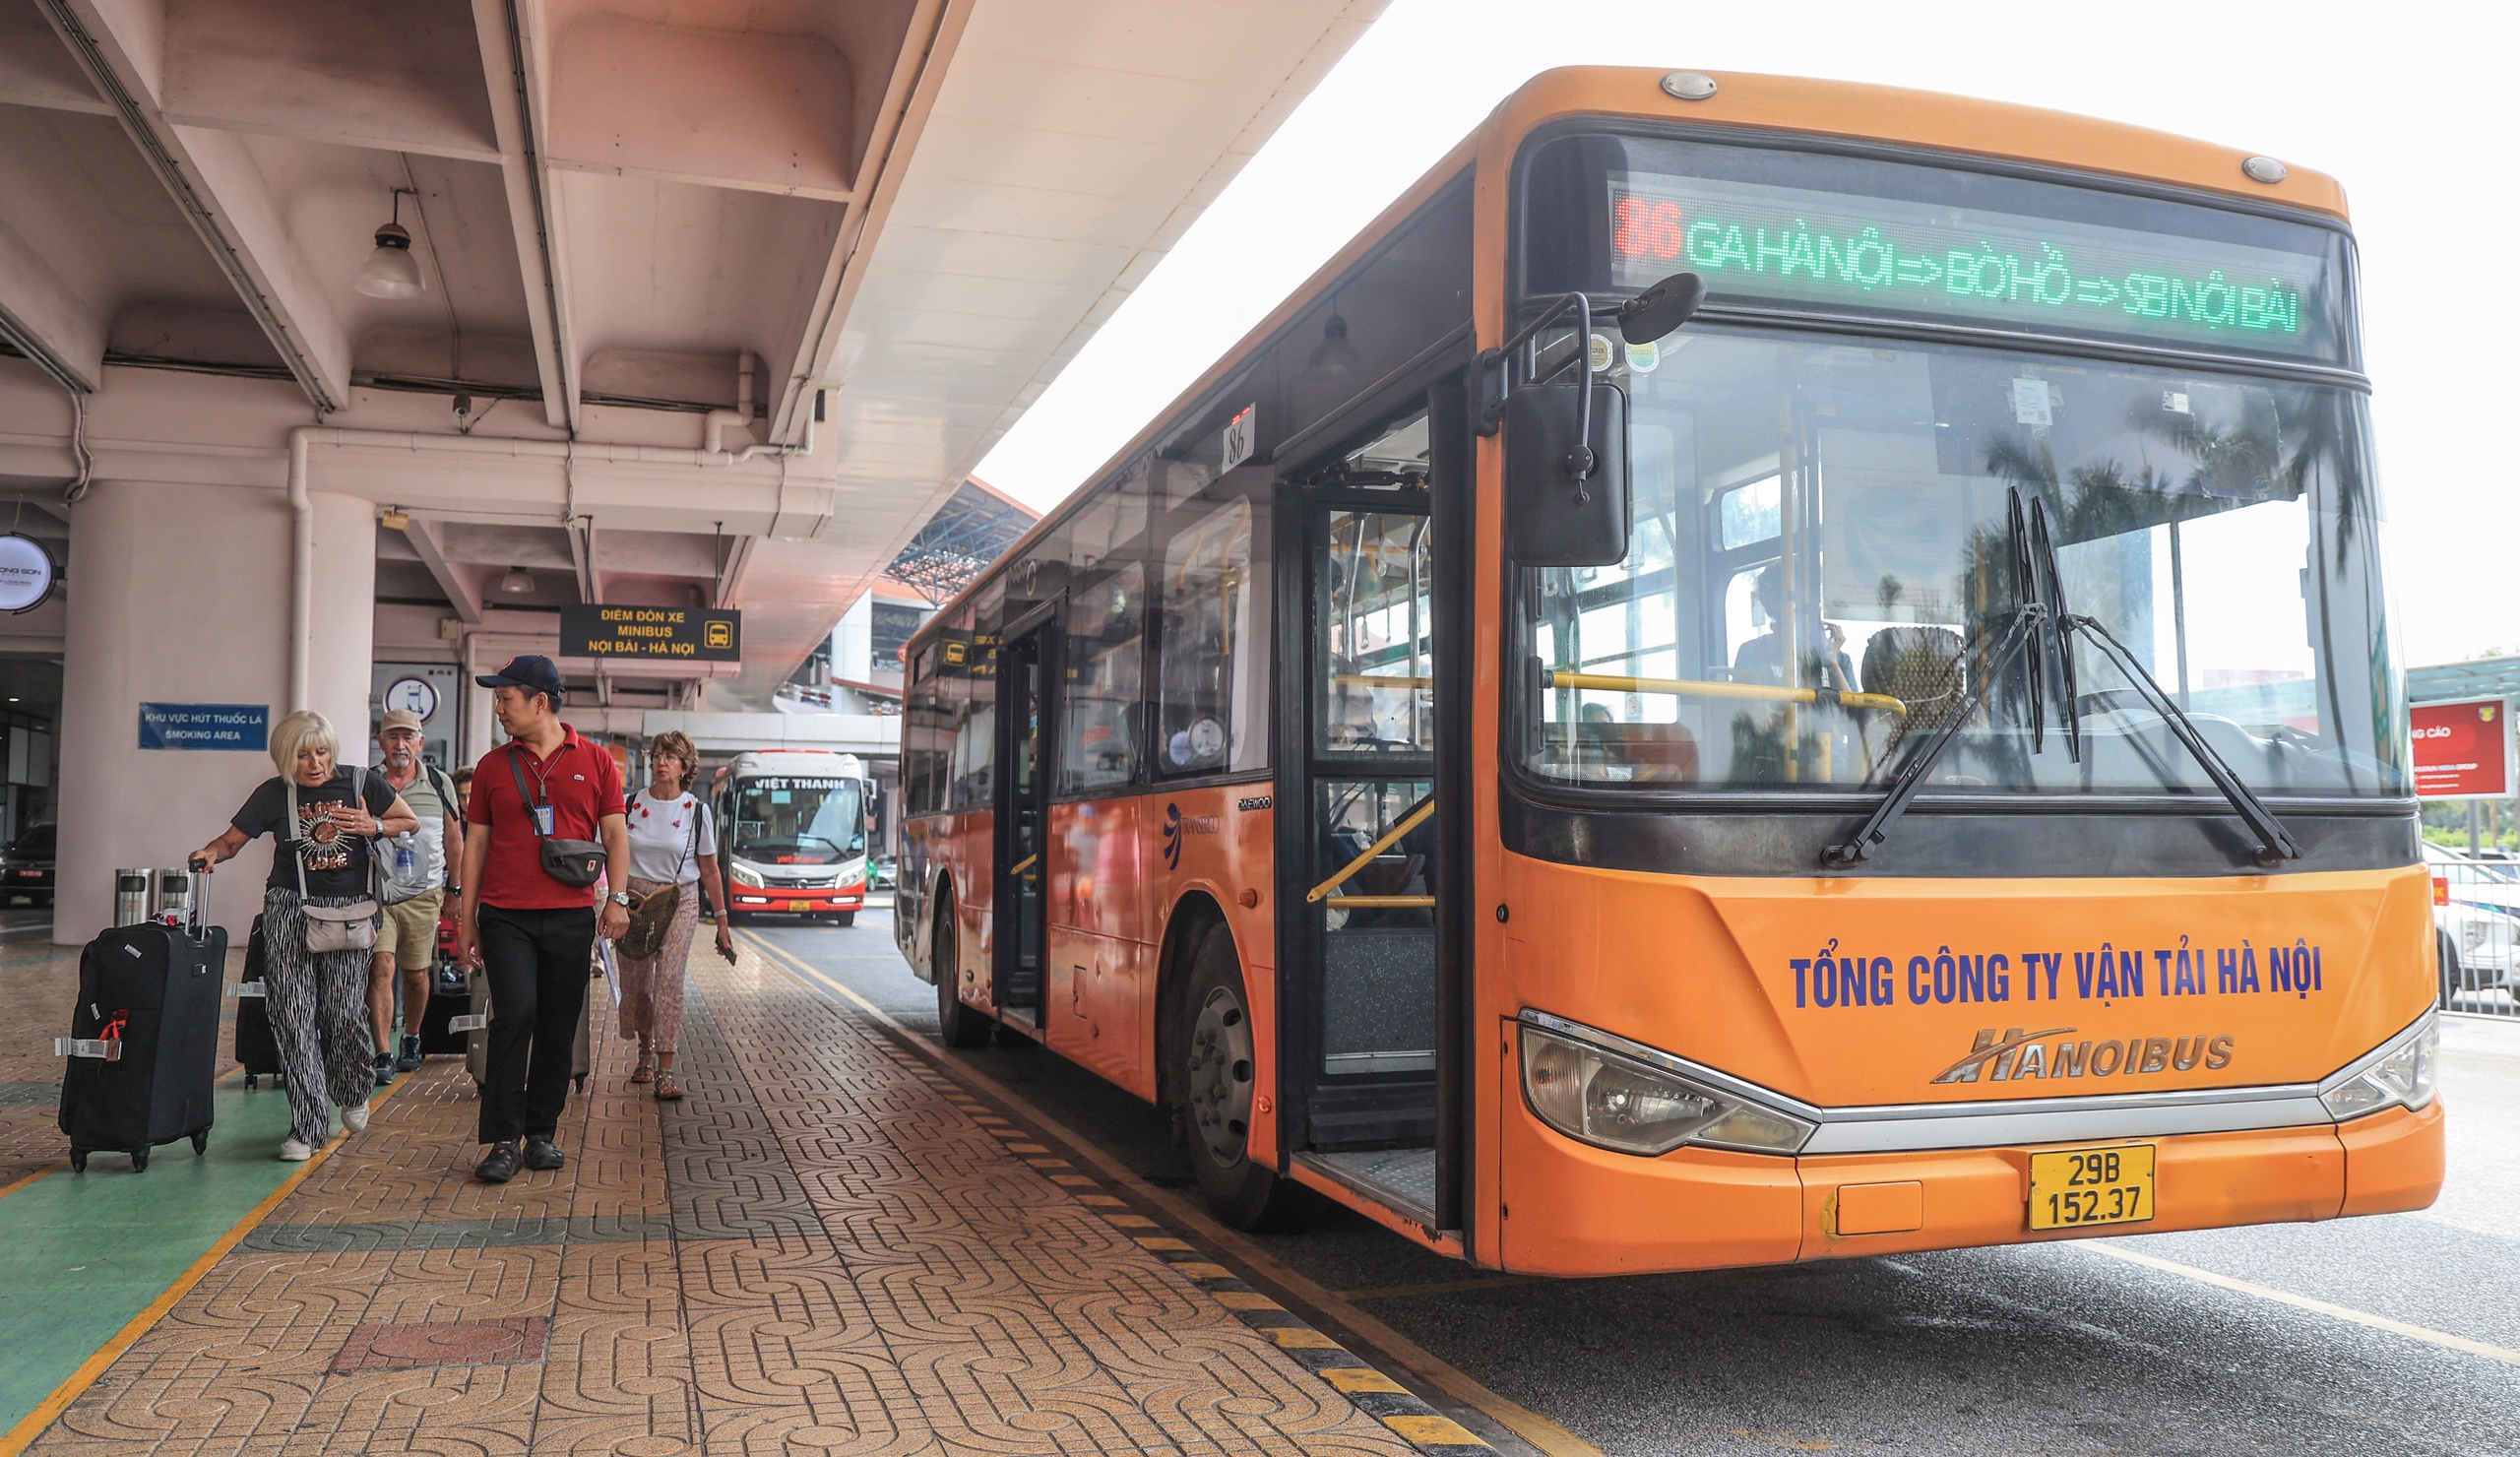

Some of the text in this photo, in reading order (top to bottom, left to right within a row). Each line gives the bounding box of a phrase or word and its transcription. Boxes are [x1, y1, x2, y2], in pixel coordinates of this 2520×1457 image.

[1617, 197, 1682, 259] 86
[1686, 221, 1751, 271] GA
[1756, 218, 1821, 279] HÀ
[1819, 225, 1894, 291] NỘI
[2009, 241, 2070, 305] HỒ
[2123, 273, 2168, 317] SB
[2171, 270, 2236, 330] NỘI
[2240, 277, 2297, 332] BÀI
[1229, 421, 1244, 464] 86
[667, 612, 685, 622] XE
[617, 625, 673, 638] MINIBUS
[588, 640, 612, 655] NỘI
[615, 639, 638, 653] BÀI
[649, 641, 668, 654] HÀ
[671, 642, 695, 657] NỘI
[168, 714, 189, 725] VỰC
[191, 712, 211, 723] HÚT
[214, 712, 247, 724] THUỐC
[249, 714, 263, 725] LÁ
[165, 729, 241, 740] SMOKING AREA
[755, 777, 846, 791] VIỆT THANH
[1238, 797, 1271, 810] DAEWOO
[1181, 815, 1221, 835] TRANSERCO
[1790, 934, 2322, 1009] TỔNG CÔNG TY VẬN TẢI HÀ NỘI
[1929, 1027, 2236, 1084] HANOIBUS
[2068, 1152, 2120, 1185] 29B
[2048, 1186, 2141, 1224] 152.37
